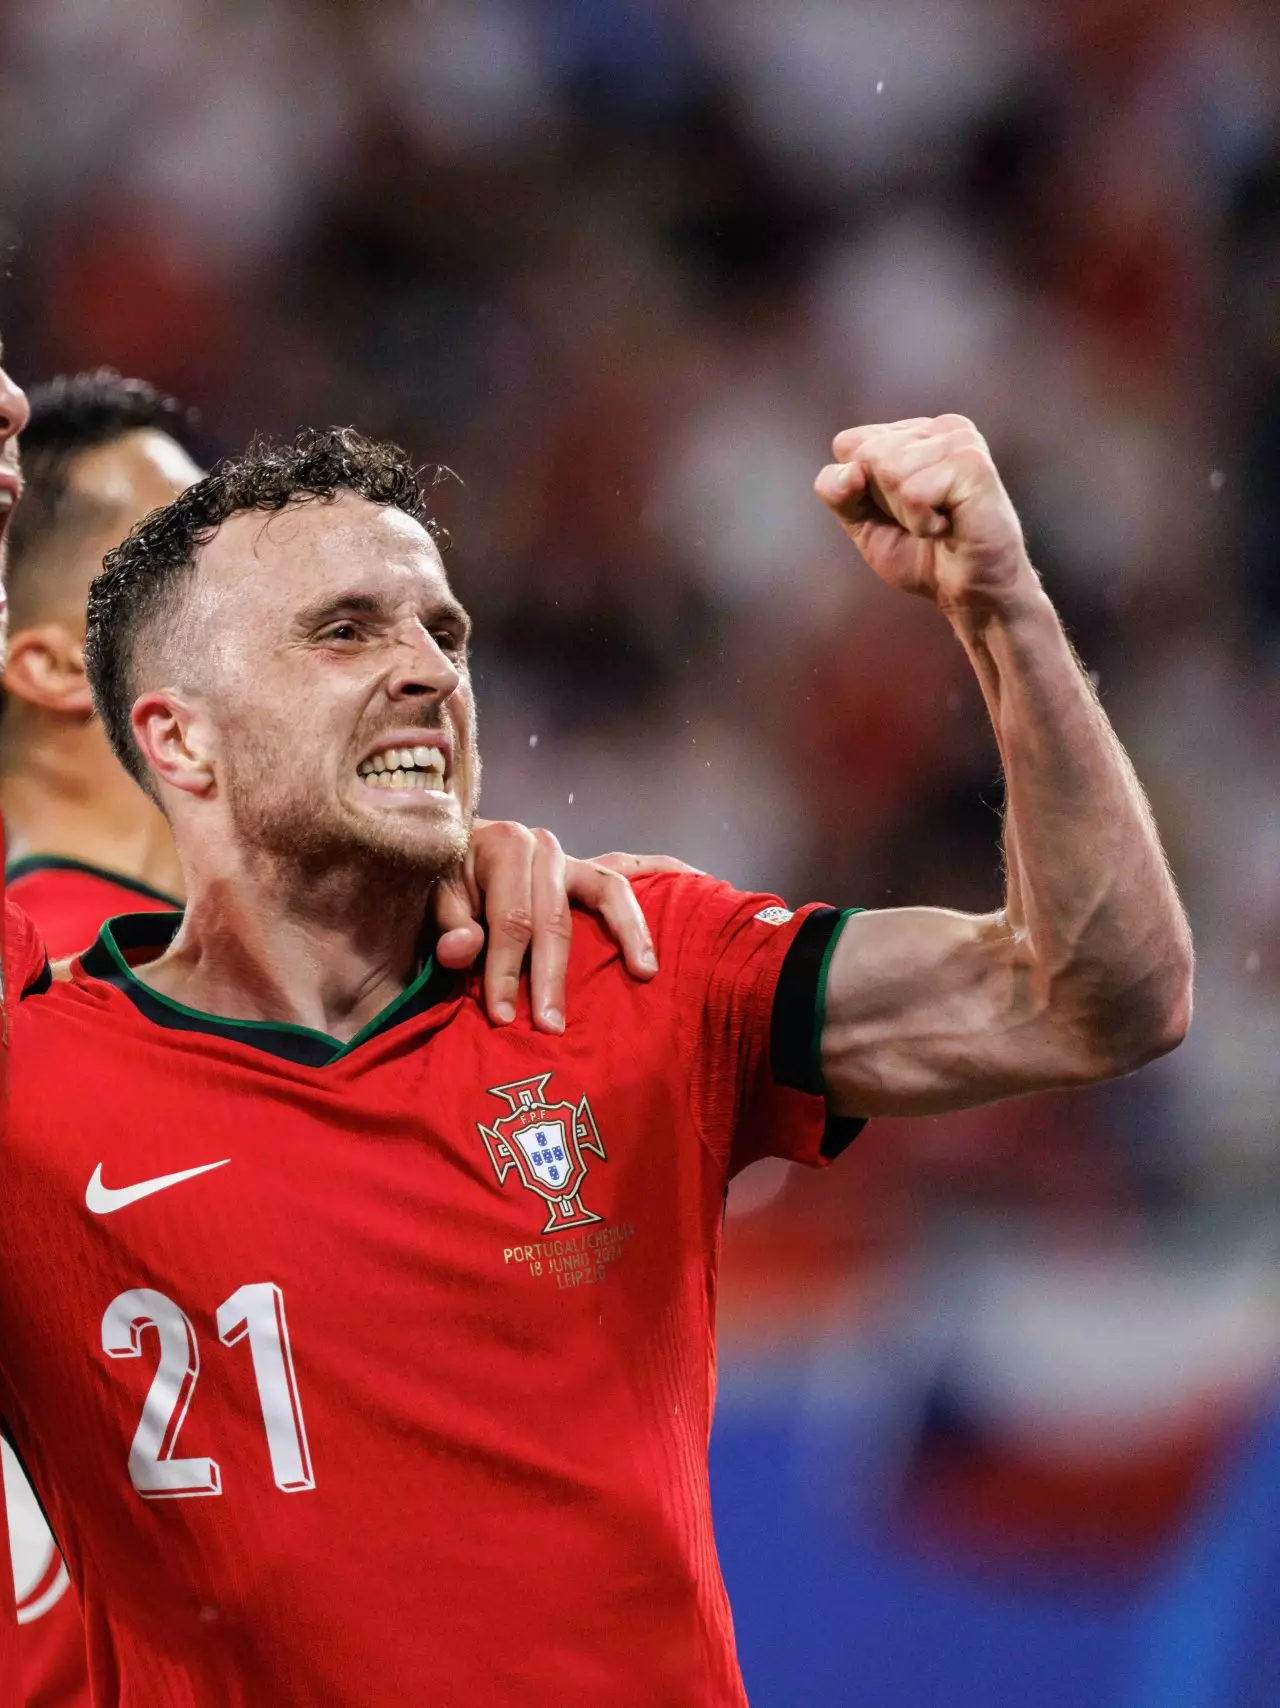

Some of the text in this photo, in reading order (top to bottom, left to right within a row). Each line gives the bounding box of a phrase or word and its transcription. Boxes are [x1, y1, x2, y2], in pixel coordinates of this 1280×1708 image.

[529, 1261, 543, 1277] 18
[548, 1252, 590, 1274] JUNHO
[556, 1264, 606, 1290] LEIPZIG
[101, 1282, 316, 1499] 21
